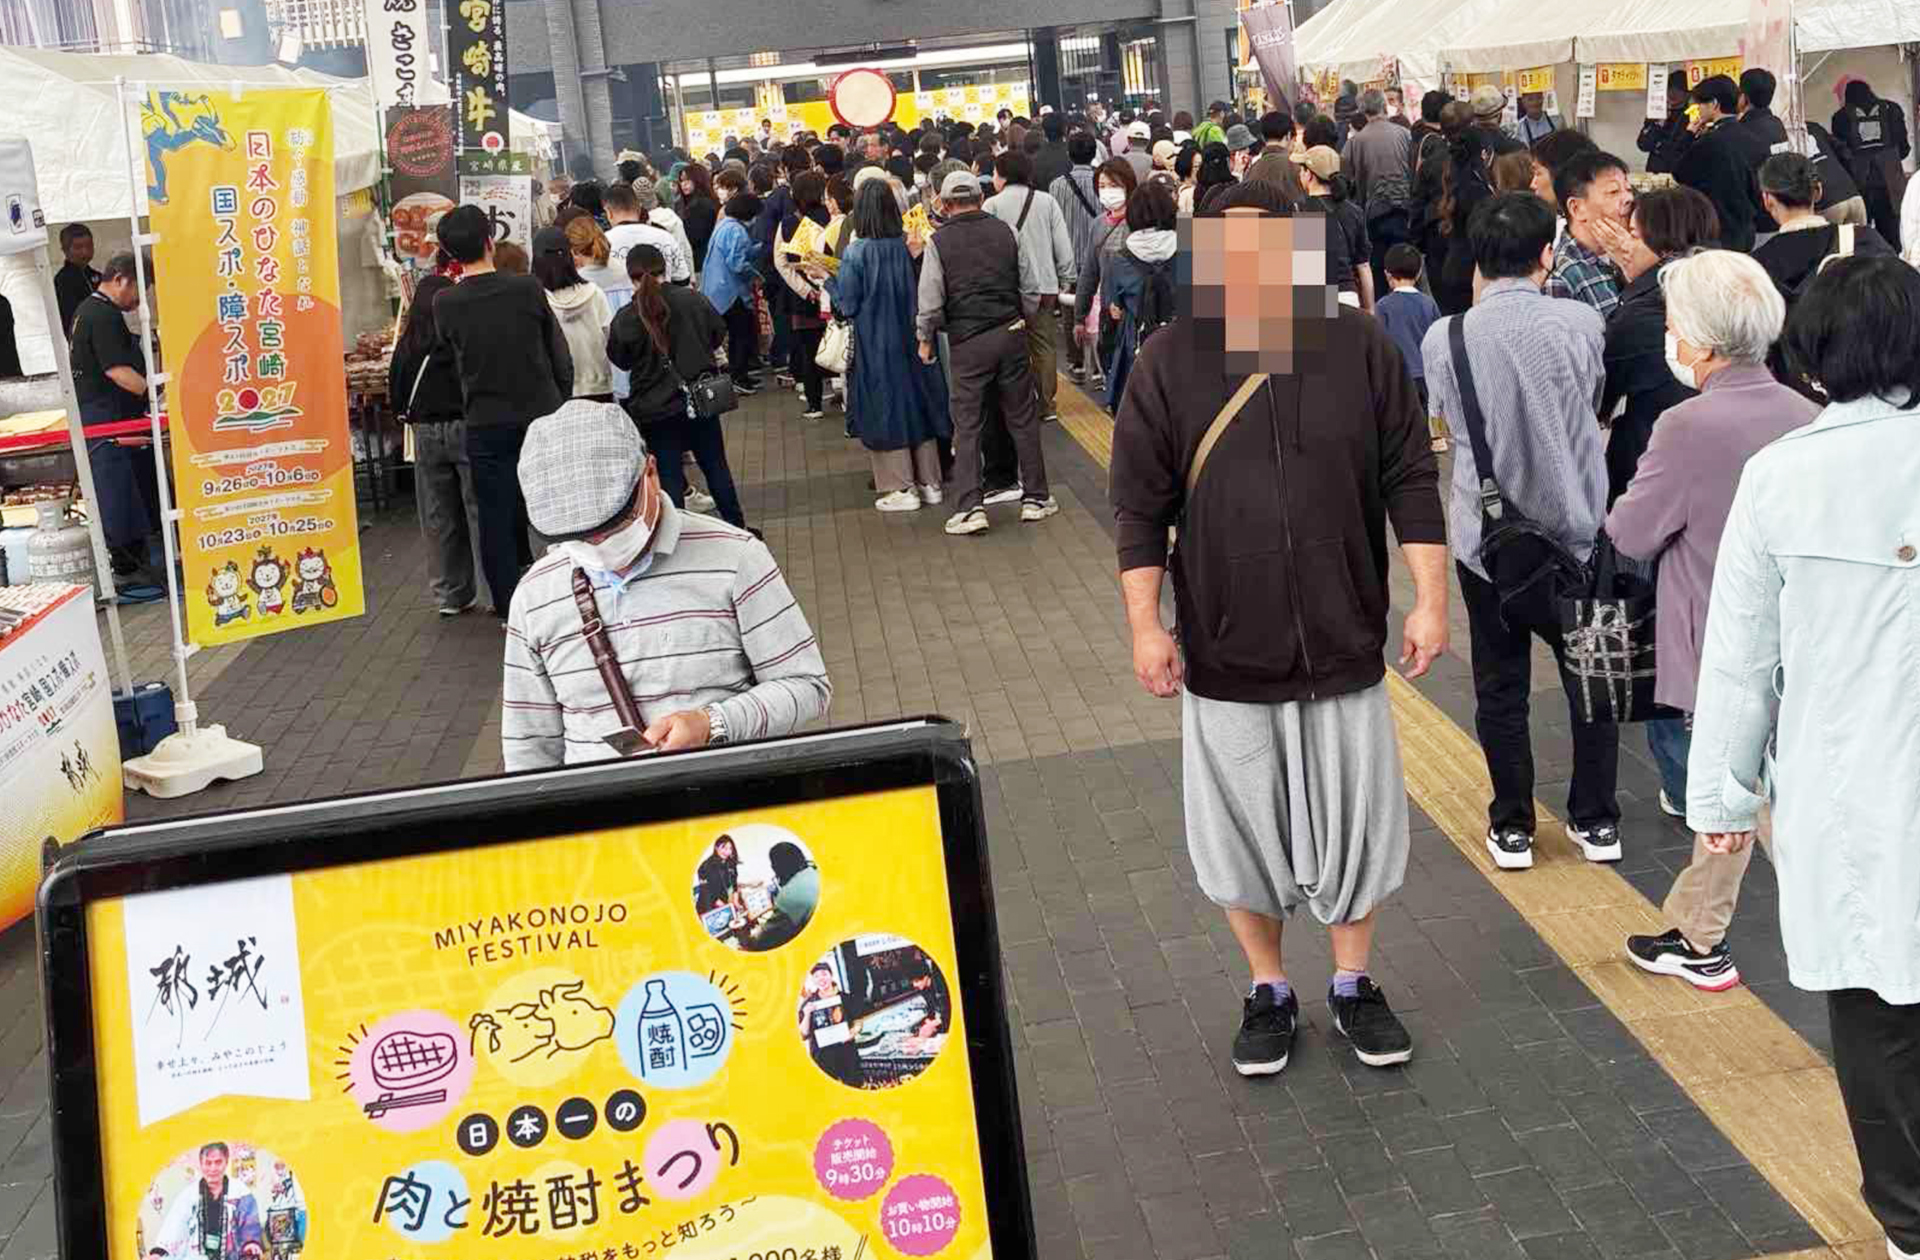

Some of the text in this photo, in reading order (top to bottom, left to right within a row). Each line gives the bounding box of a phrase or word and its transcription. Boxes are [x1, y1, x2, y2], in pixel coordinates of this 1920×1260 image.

[246, 131, 287, 380] 日本のひなた宮崎
[213, 187, 249, 382] 国スポ・障スポ
[434, 903, 628, 950] MIYAKONOJO
[467, 930, 599, 967] FESTIVAL
[648, 1022, 676, 1070] 焼酎
[467, 1100, 637, 1148] 日本一の
[832, 1134, 871, 1150] チケット
[373, 1122, 740, 1239] 肉と焼酎まつり
[825, 1164, 887, 1187] 9時30分
[888, 1213, 957, 1239] 10時10分
